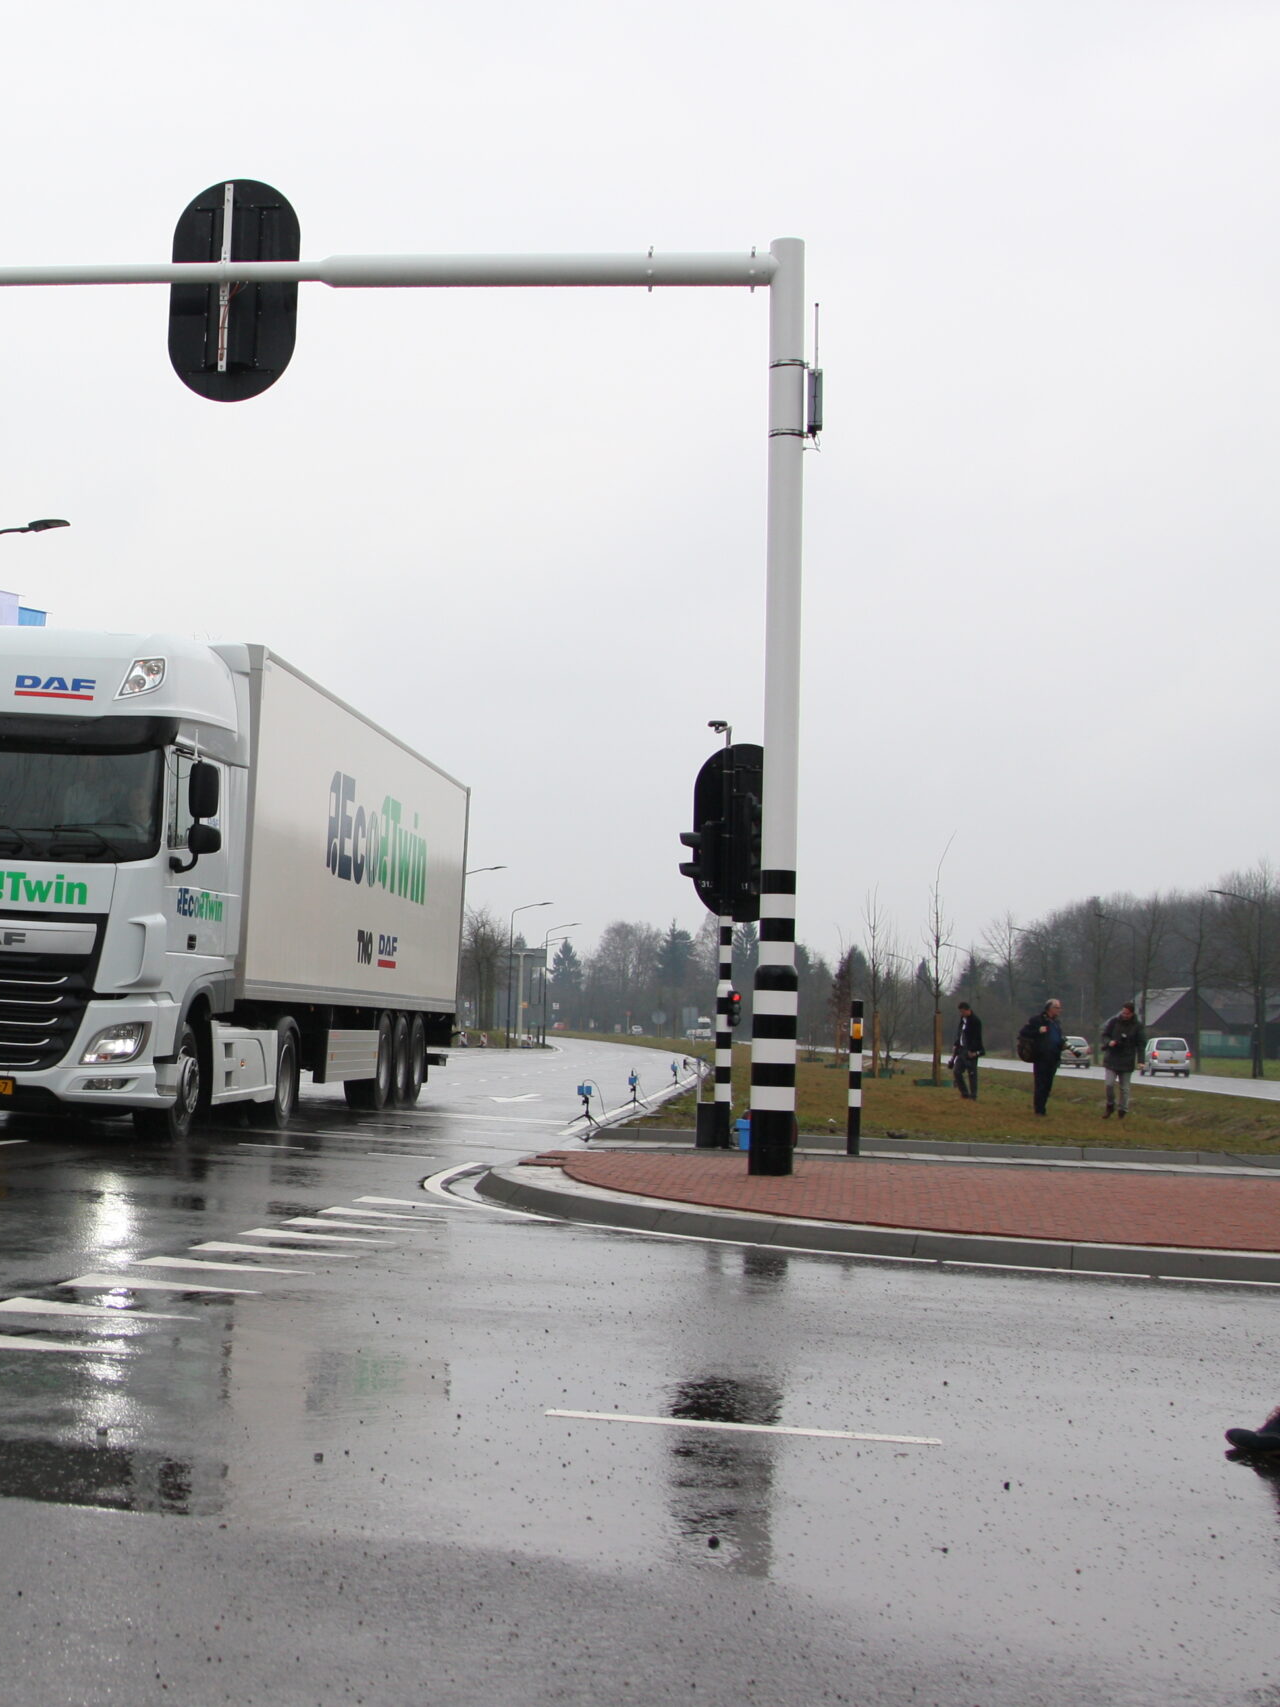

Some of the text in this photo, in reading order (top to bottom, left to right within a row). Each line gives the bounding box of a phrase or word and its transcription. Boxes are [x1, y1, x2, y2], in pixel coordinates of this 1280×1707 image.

[15, 675, 96, 692] DAF
[357, 929, 398, 965] TNO DAF
